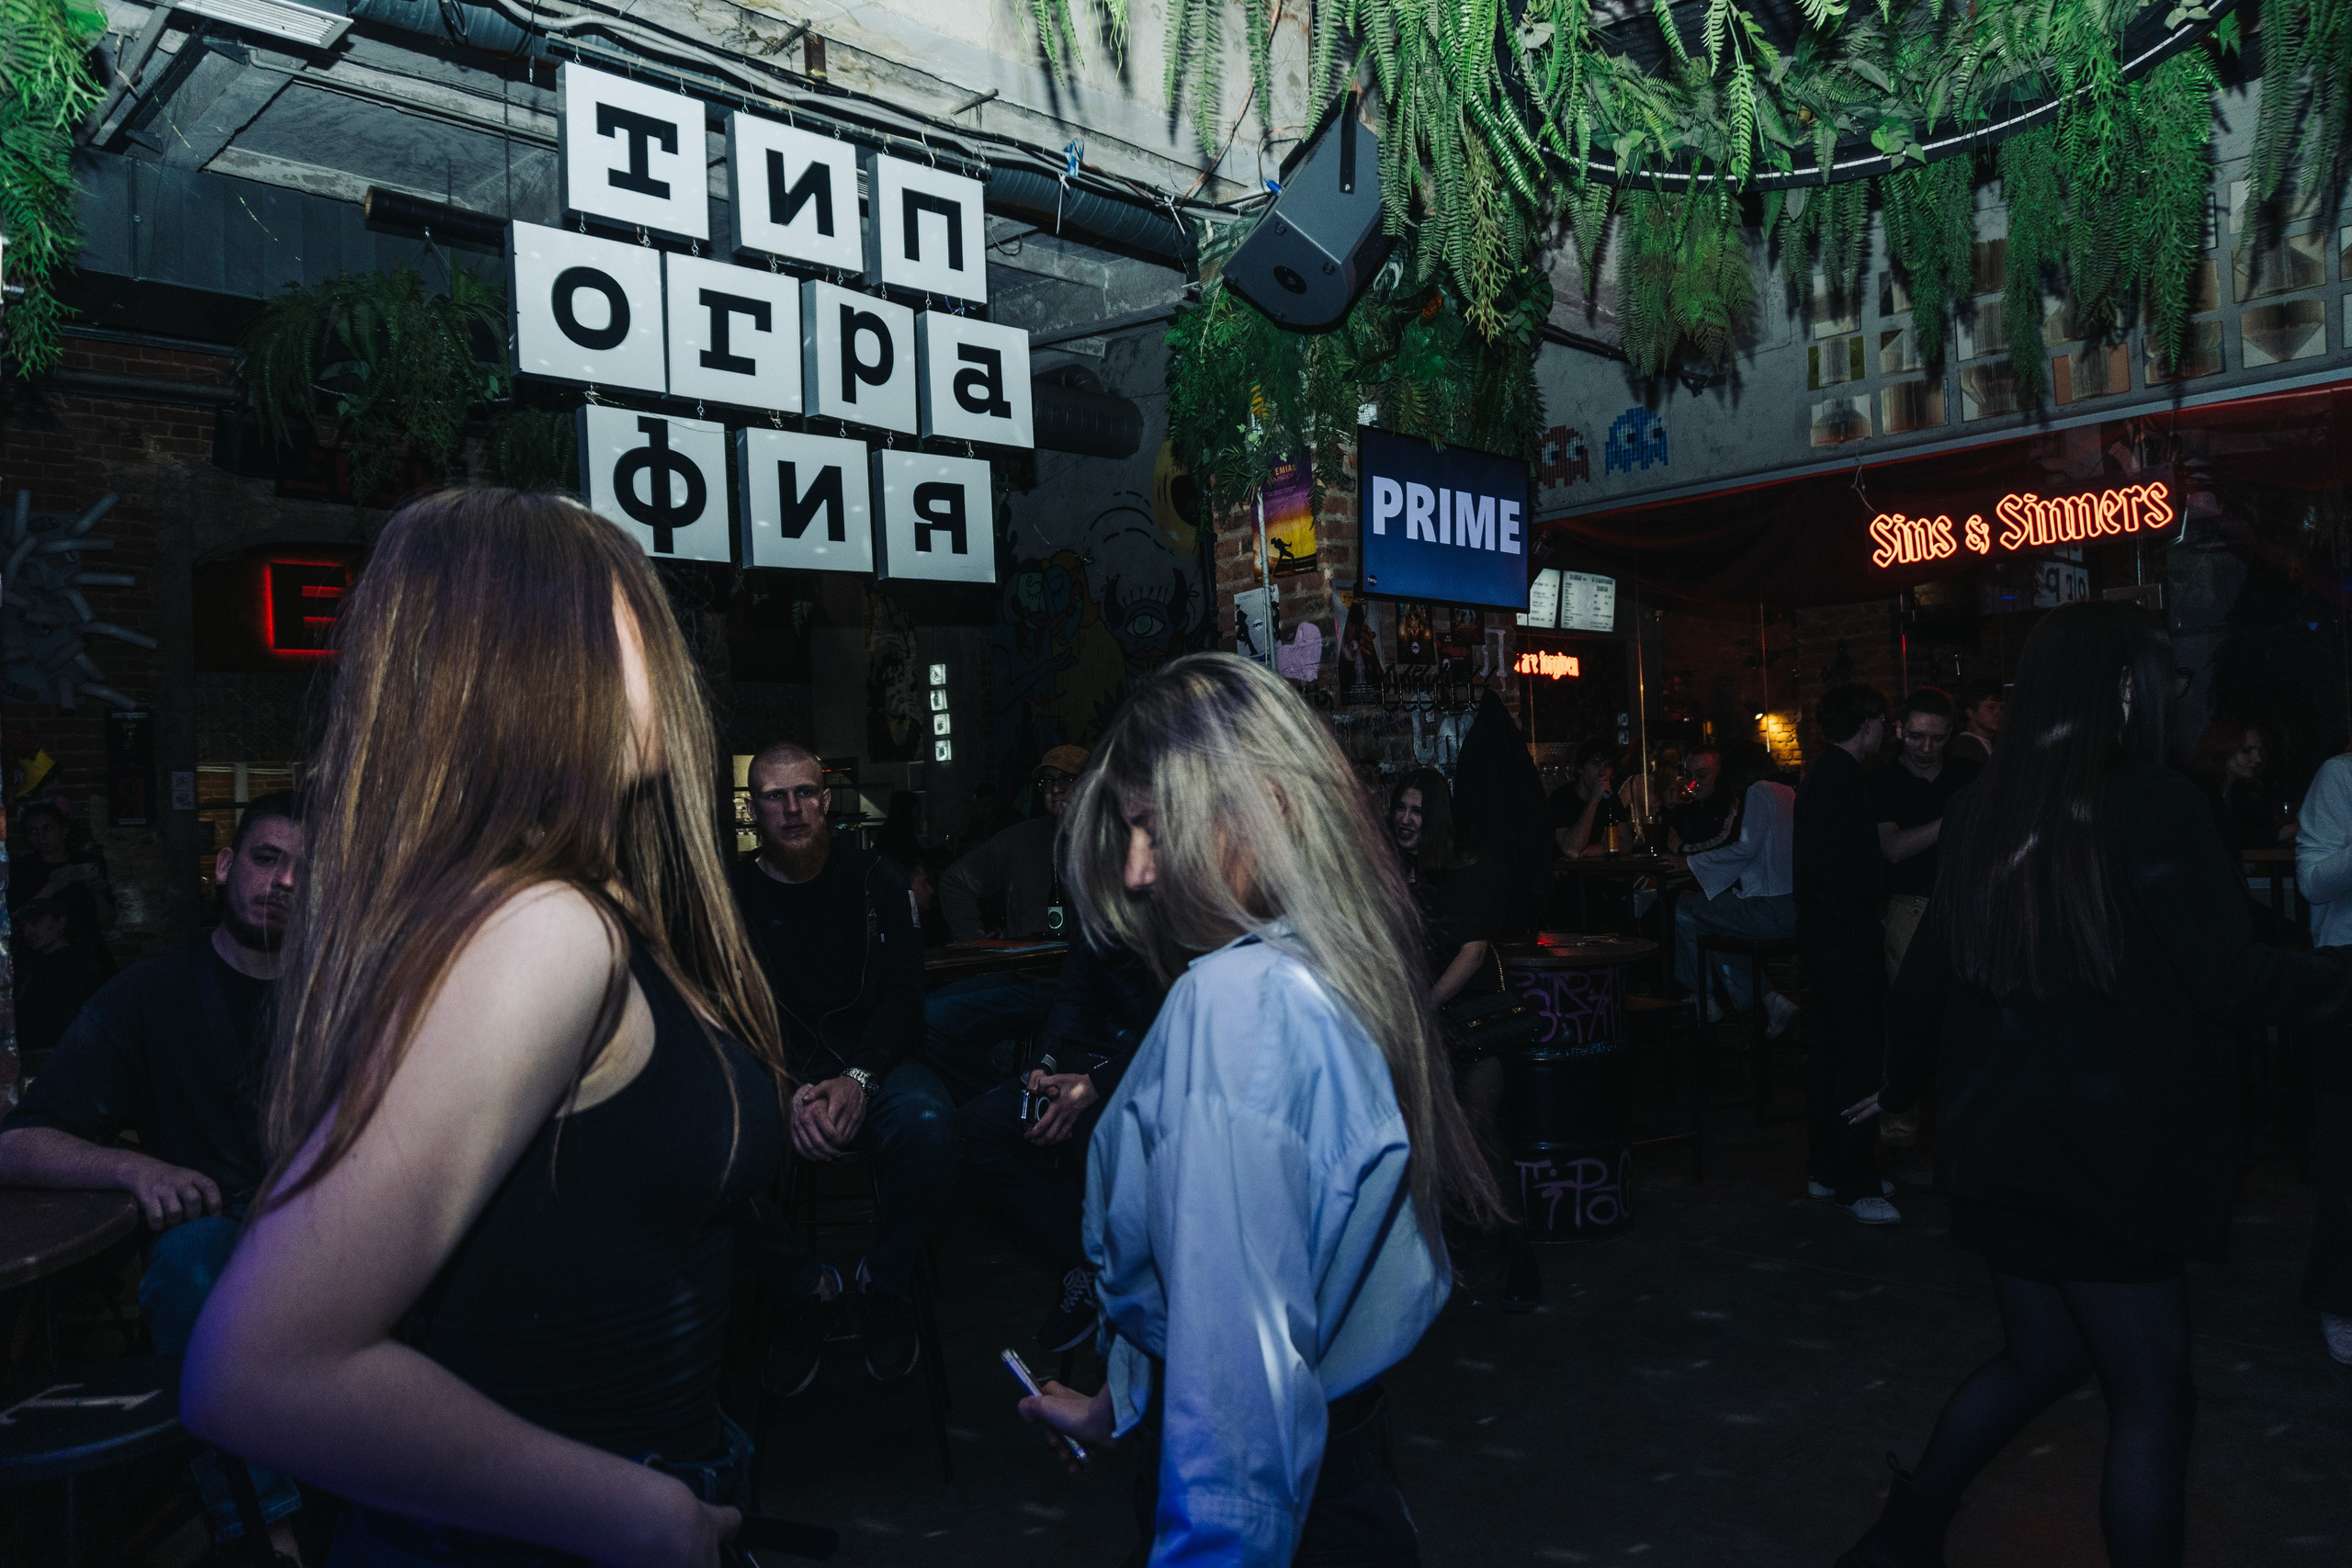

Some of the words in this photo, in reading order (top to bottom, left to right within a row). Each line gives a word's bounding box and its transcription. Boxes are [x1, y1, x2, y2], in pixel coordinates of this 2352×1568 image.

[1373, 475, 1521, 555] PRIME
[1869, 513, 1957, 568] Sins
[1964, 514, 1990, 555] &
[1996, 481, 2174, 550] Sinners
